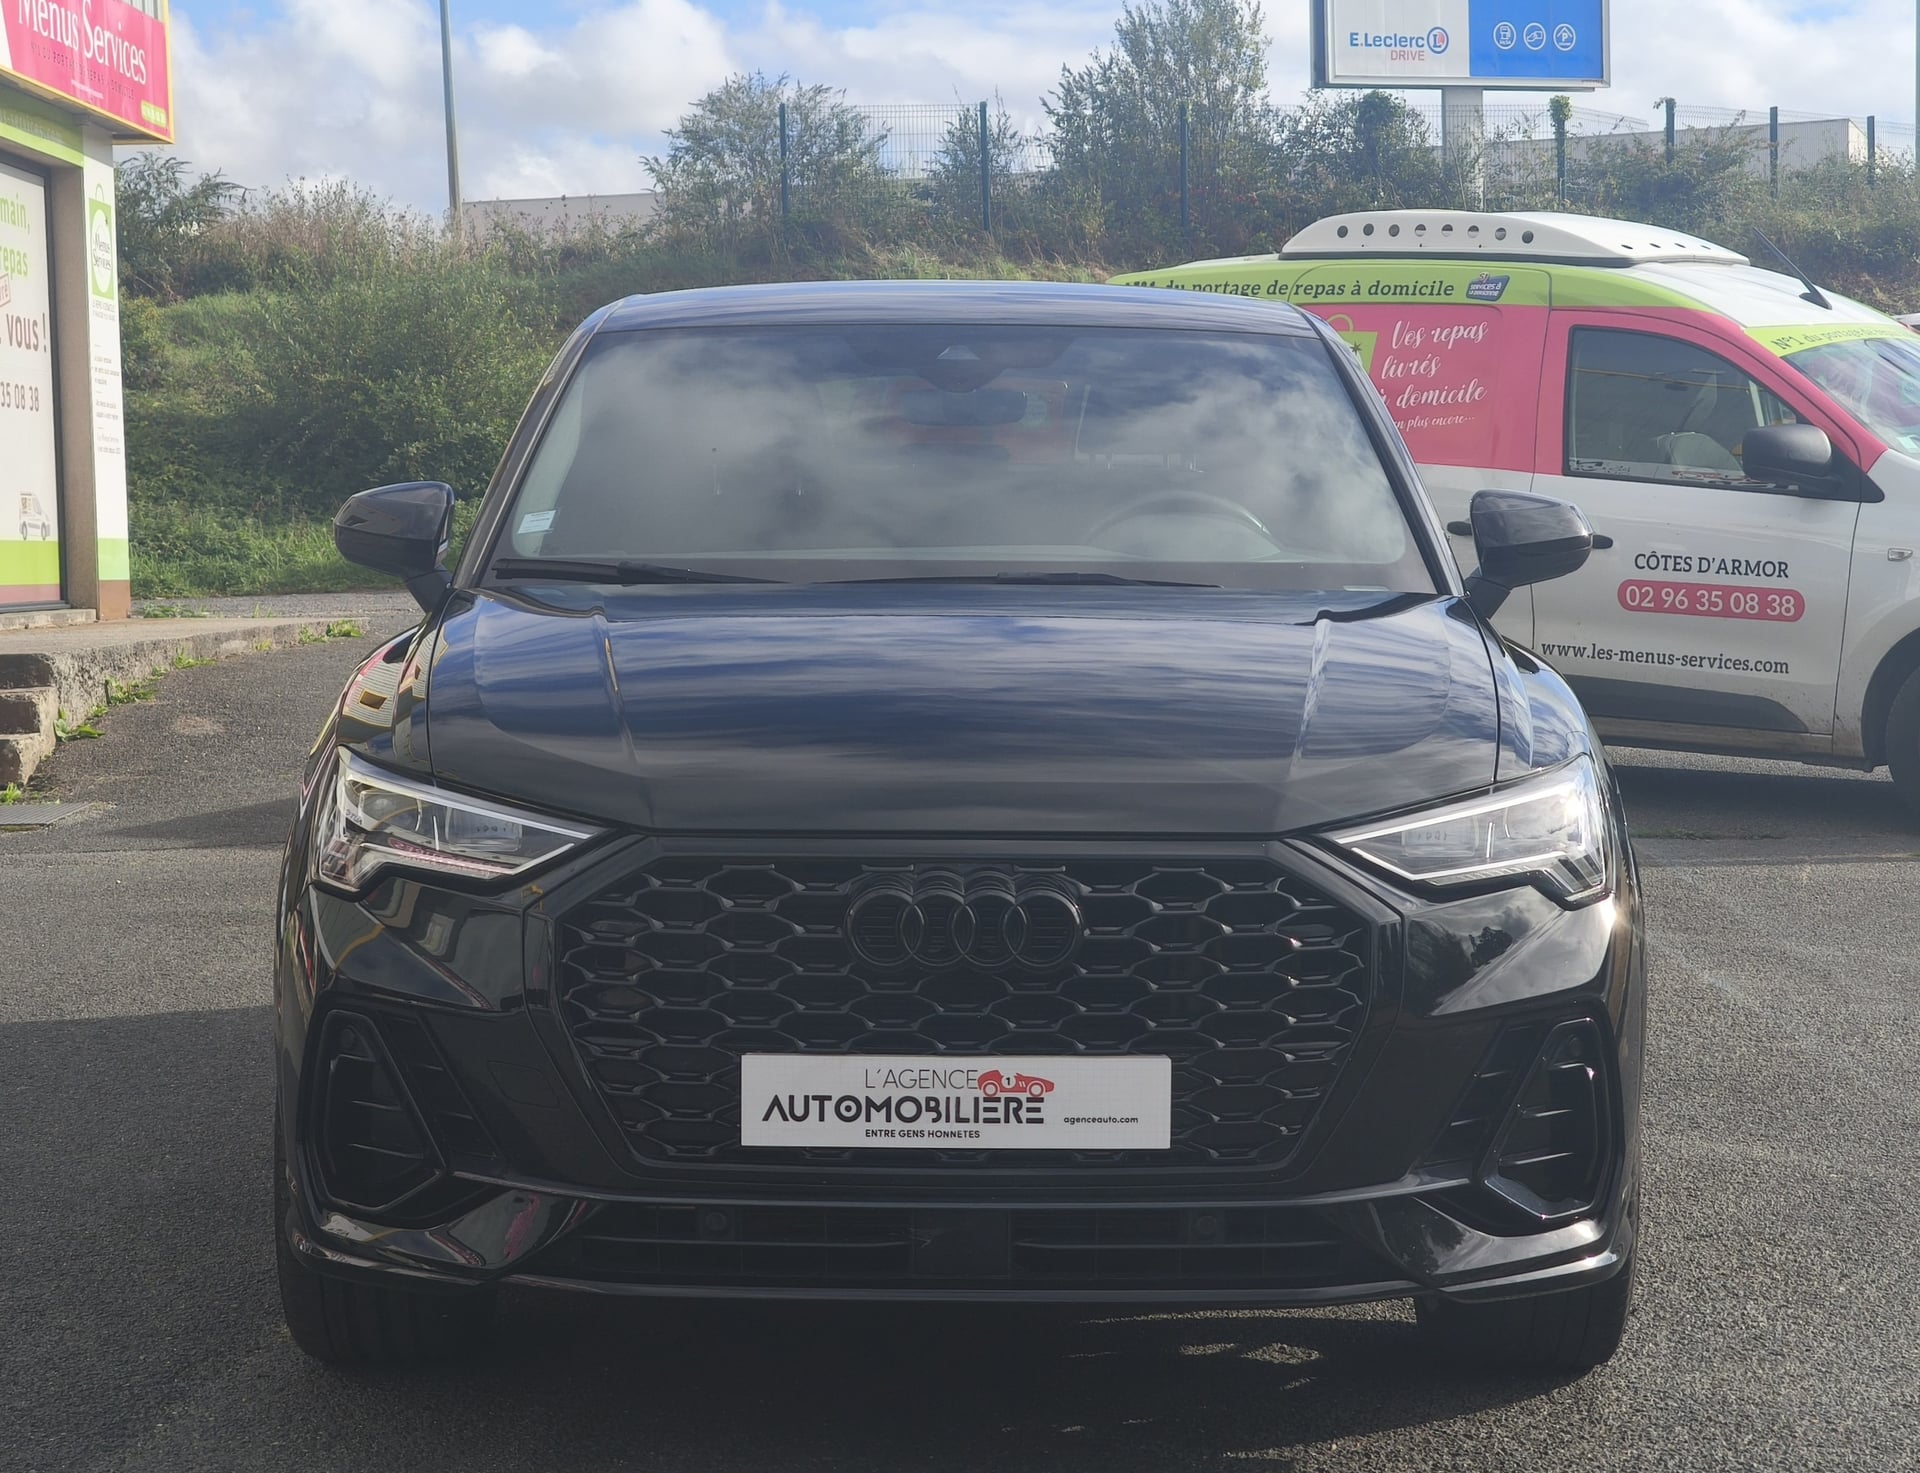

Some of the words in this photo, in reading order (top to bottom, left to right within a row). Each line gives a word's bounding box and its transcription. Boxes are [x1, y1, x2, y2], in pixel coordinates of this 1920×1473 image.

[17, 0, 79, 51] Menus
[82, 0, 147, 85] Services
[1350, 32, 1425, 48] E.Leclerc
[1390, 50, 1425, 62] DRIVE
[1266, 280, 1289, 296] de
[1293, 282, 1346, 299] repas
[1350, 280, 1362, 297] à
[1367, 280, 1454, 297] domicile
[1392, 320, 1426, 350] Vos
[1431, 321, 1488, 350] repas
[1381, 353, 1441, 380] livrés
[0, 382, 11, 408] 35
[14, 384, 26, 410] 08
[28, 386, 40, 412] 38
[1396, 378, 1488, 409] domicile
[1406, 416, 1430, 432] plus
[1634, 551, 1693, 572] CÔTES
[1697, 557, 1790, 578] D'ARMOR
[1625, 585, 1655, 608] 02
[1661, 588, 1689, 610] 96
[1695, 590, 1723, 612] 35
[1730, 592, 1759, 614] 08
[1766, 594, 1795, 617] 38
[1541, 642, 1790, 674] www.les-menus-services.com
[864, 1068, 979, 1090] L'AGENCE
[1063, 1114, 1139, 1125] agenceauto.com
[865, 1128, 896, 1138] ENTRE
[898, 1129, 925, 1138] GENS
[927, 1129, 981, 1139] HONNETES
